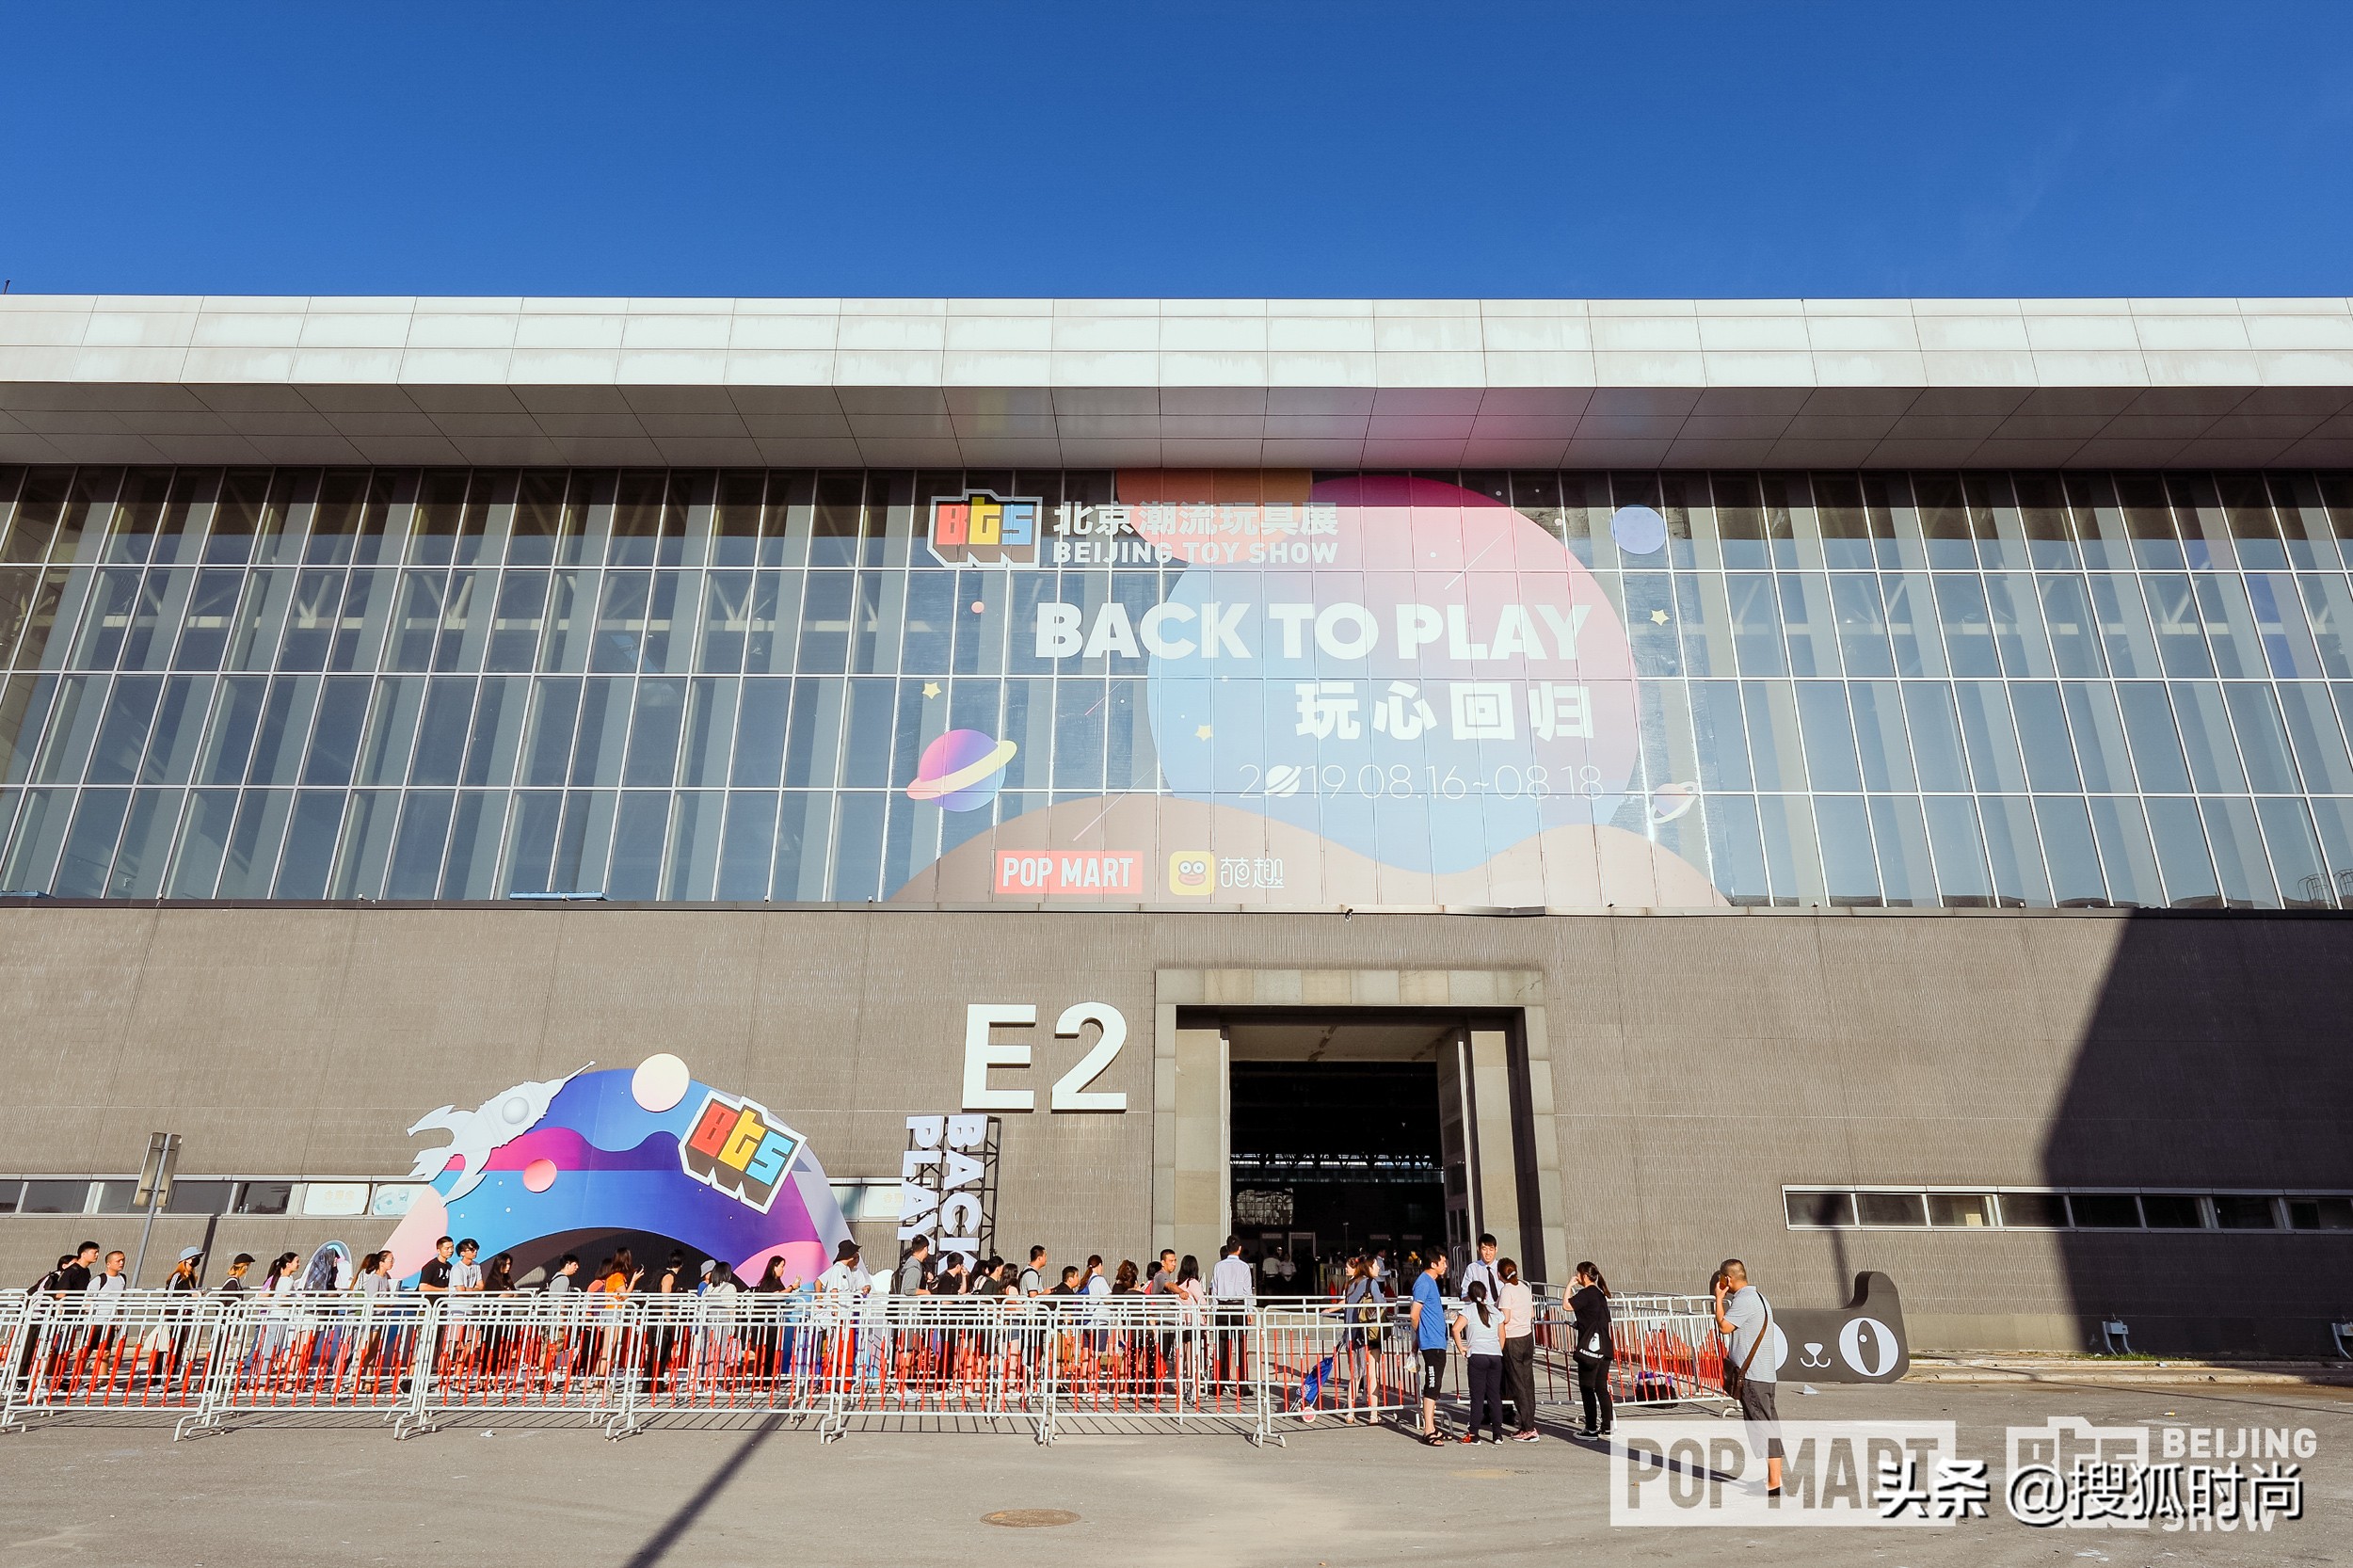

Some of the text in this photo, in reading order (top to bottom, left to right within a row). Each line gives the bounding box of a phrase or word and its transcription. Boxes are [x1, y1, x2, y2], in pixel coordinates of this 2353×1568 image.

[1052, 501, 1338, 536] 北京潮流玩具展
[1052, 541, 1338, 564] BEIJING TOY SHOW
[1035, 602, 1592, 660] BACK TO PLAY
[1294, 680, 1594, 742] 玩心回归
[1002, 857, 1134, 887] POP MART
[897, 1115, 945, 1256] PLAY
[937, 1114, 988, 1275] BACK
